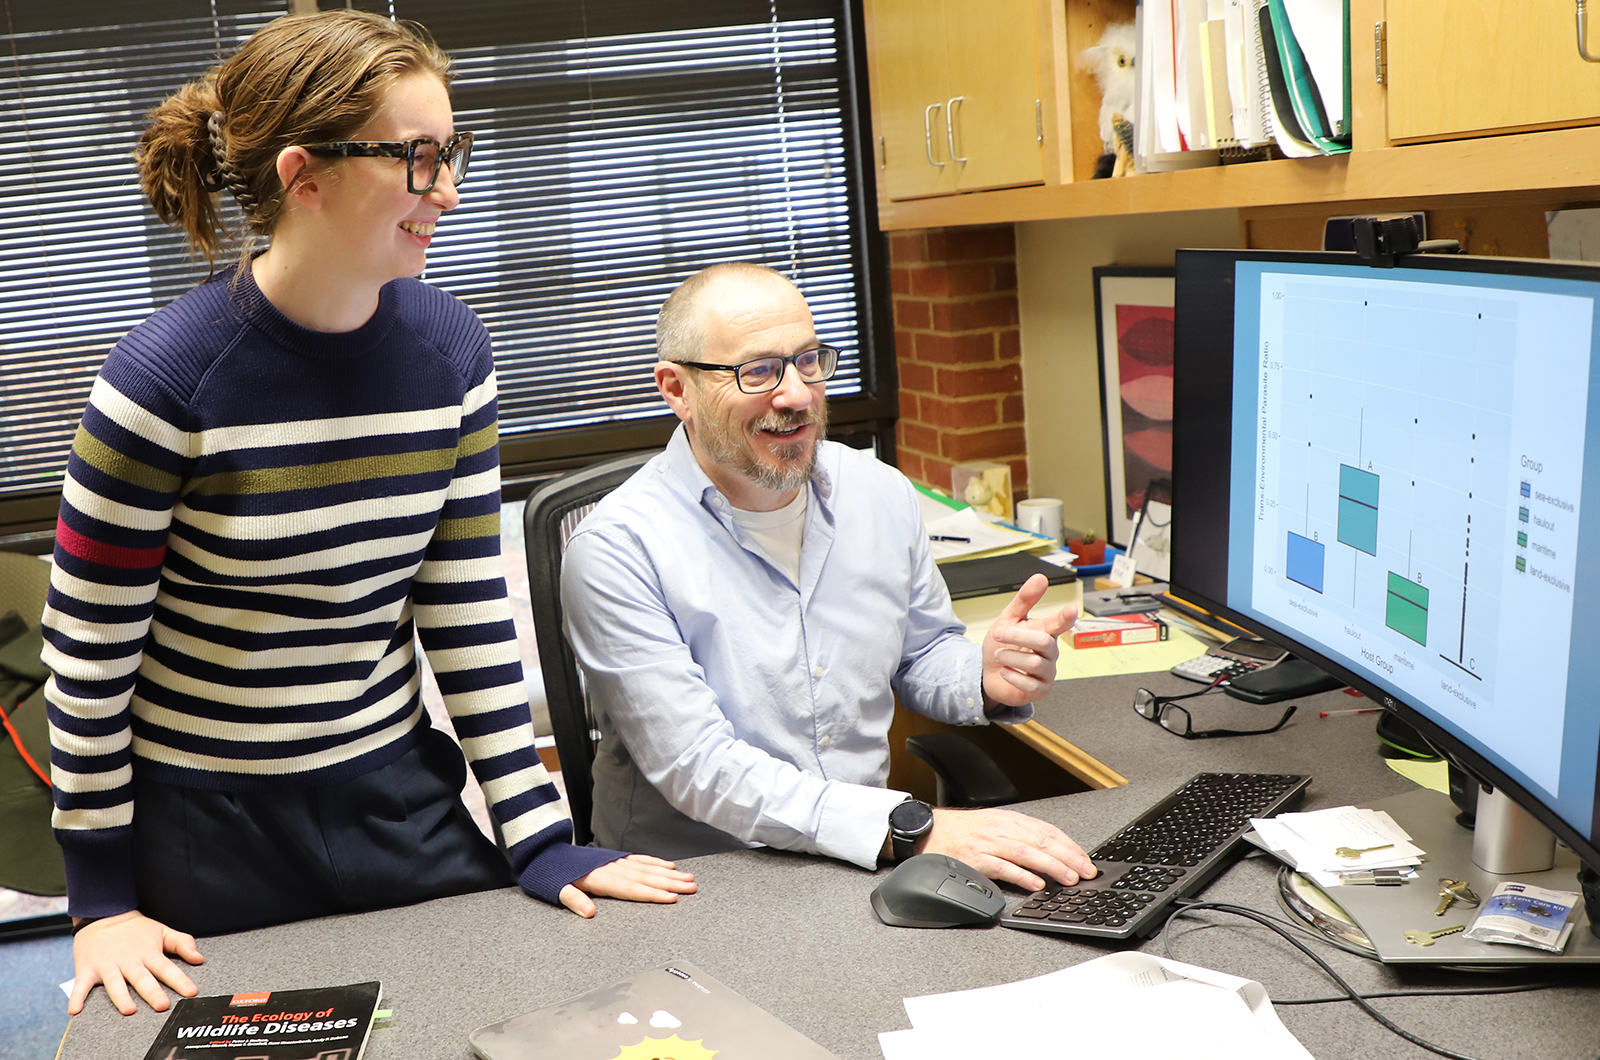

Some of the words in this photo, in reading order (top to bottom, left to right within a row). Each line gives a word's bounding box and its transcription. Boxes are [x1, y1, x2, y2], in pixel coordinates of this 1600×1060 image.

[1262, 341, 1270, 368] Ratio
[1261, 372, 1269, 414] Parasite
[1367, 461, 1373, 471] A
[1520, 454, 1543, 475] Group
[1535, 490, 1574, 513] sea-exclusive
[1533, 514, 1555, 532] haulout
[1313, 531, 1319, 542] B
[1532, 541, 1556, 559] maritime
[1416, 572, 1422, 584] B
[1530, 564, 1570, 593] land-exclusive
[1343, 625, 1362, 641] haulout
[1361, 646, 1375, 664] Host
[1375, 655, 1394, 675] Group
[1469, 657, 1476, 670] C
[1440, 680, 1477, 710] land-exclusive
[1533, 900, 1552, 908] Care
[1552, 904, 1565, 912] Kit
[221, 1013, 249, 1024] The
[251, 1011, 314, 1023] Ecology
[315, 1007, 335, 1018] of
[177, 1023, 260, 1039] Wildlife
[262, 1017, 358, 1035] Diseases
